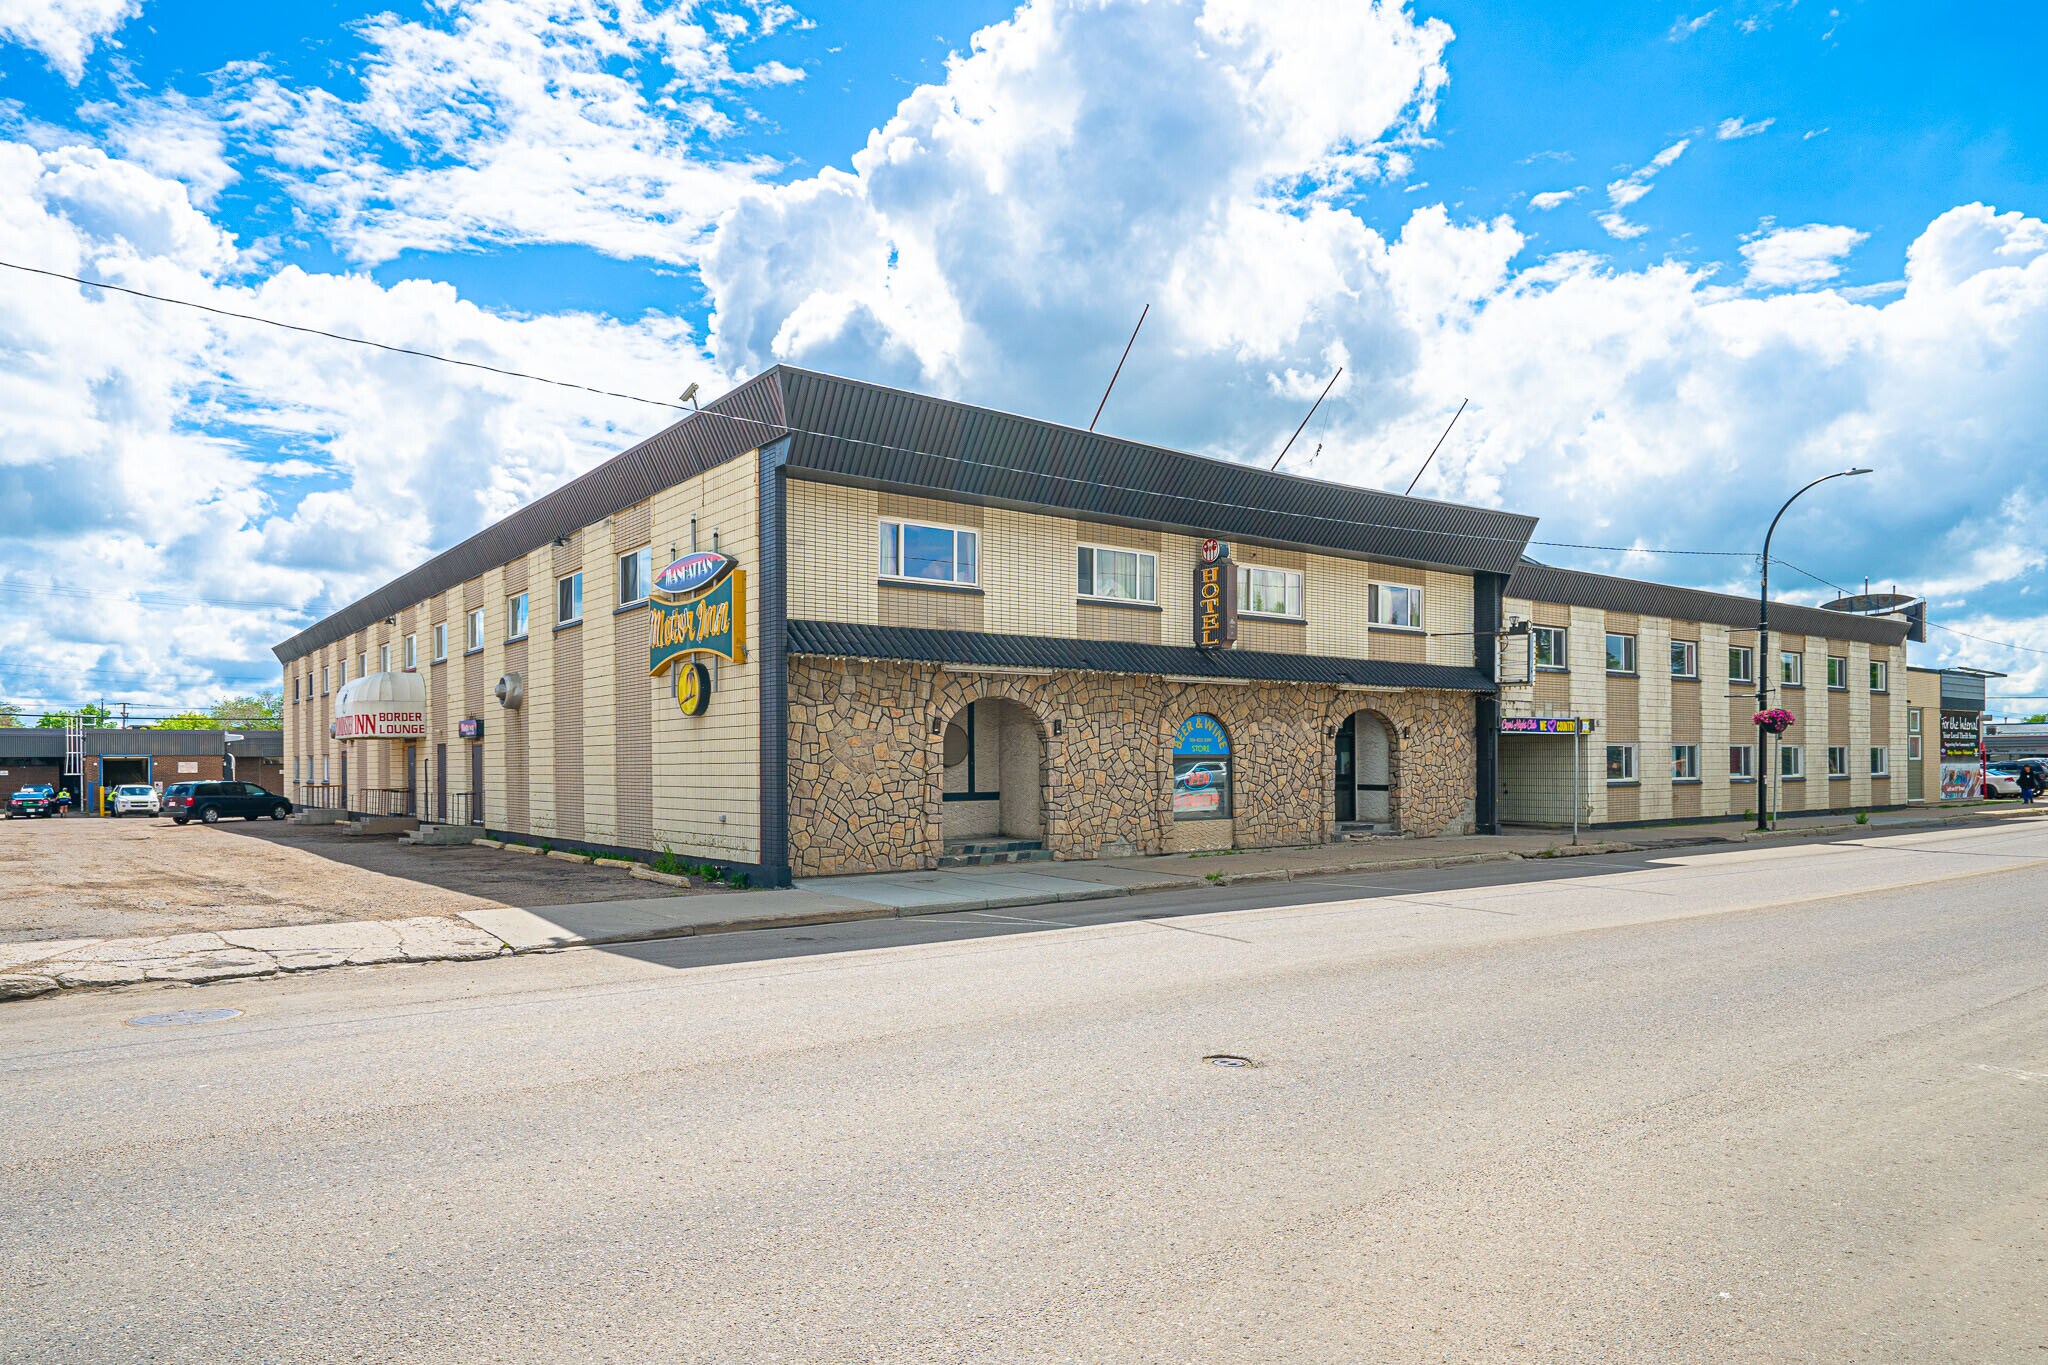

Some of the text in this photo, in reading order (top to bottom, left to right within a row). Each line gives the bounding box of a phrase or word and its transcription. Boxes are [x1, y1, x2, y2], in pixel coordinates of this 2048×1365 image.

[1200, 567, 1220, 645] HOTEL
[650, 599, 730, 648] Motor Inn
[354, 713, 377, 735] INN
[379, 712, 423, 722] BORDER
[379, 724, 425, 734] LOUNGE
[1174, 717, 1227, 749] BEER & WINE
